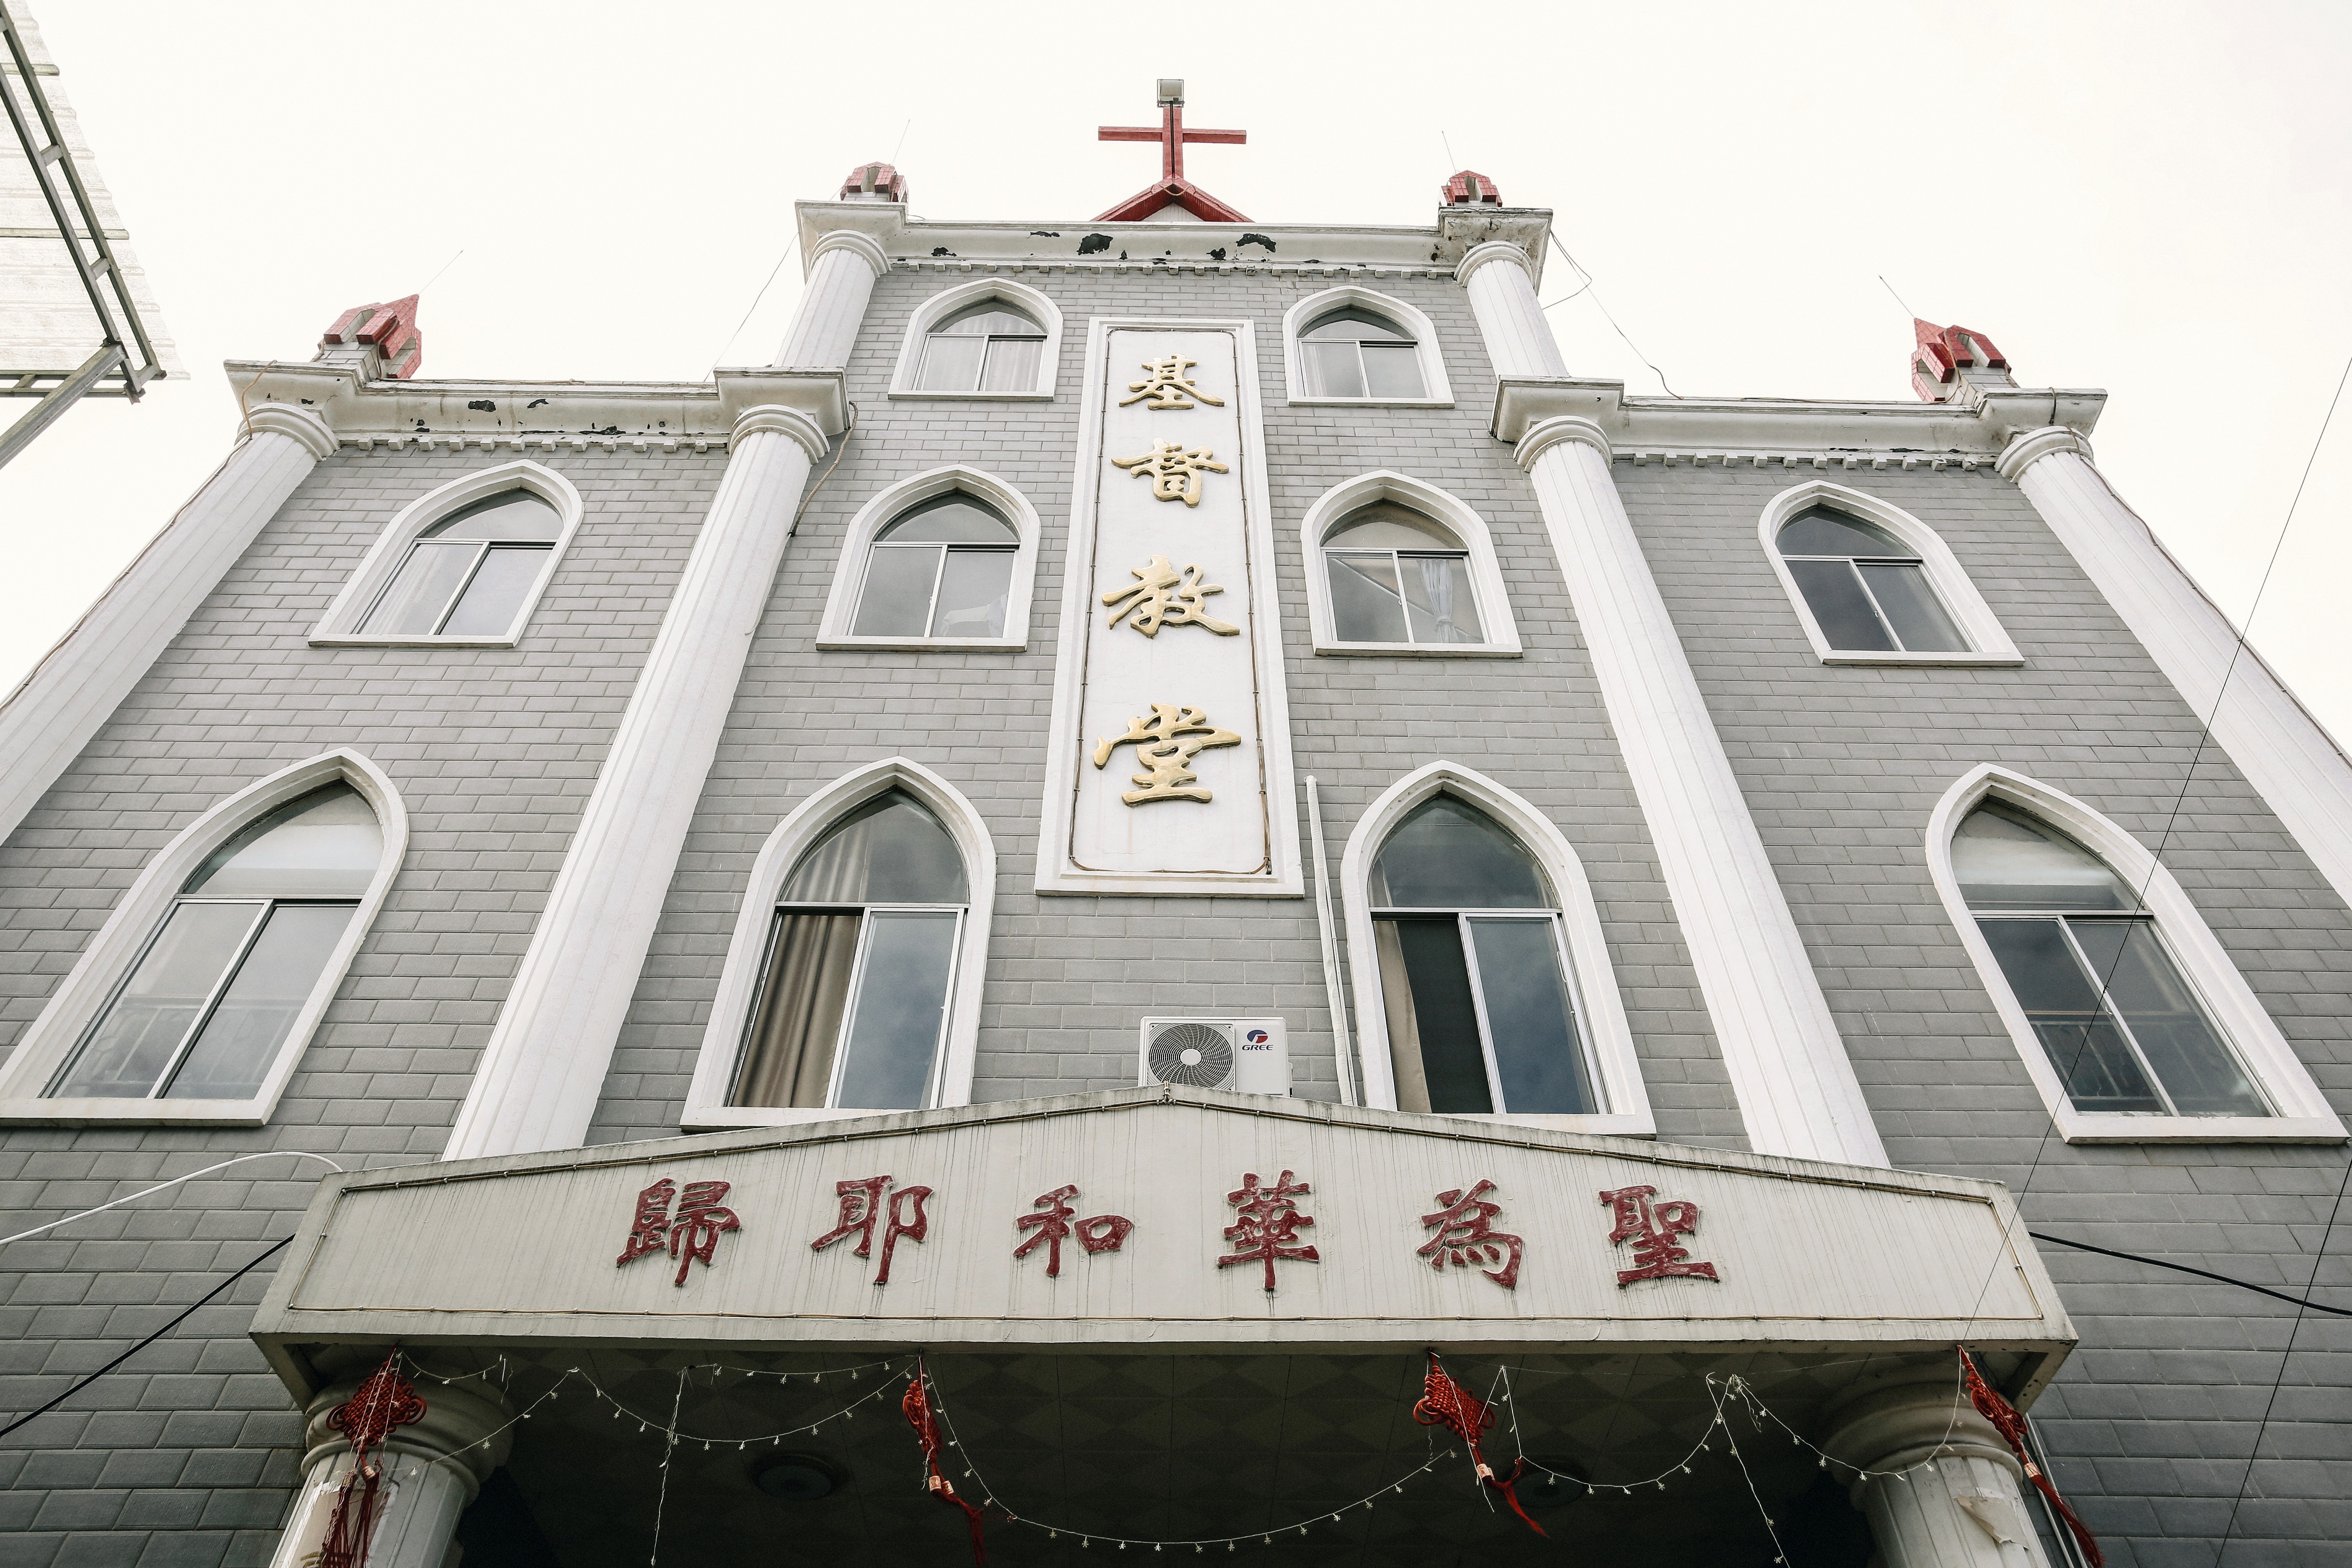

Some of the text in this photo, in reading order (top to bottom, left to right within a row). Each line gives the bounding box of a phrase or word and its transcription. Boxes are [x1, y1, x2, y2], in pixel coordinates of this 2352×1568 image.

[1094, 354, 1241, 807] 基督教堂
[616, 1169, 1719, 1289] 歸耶和華為聖
